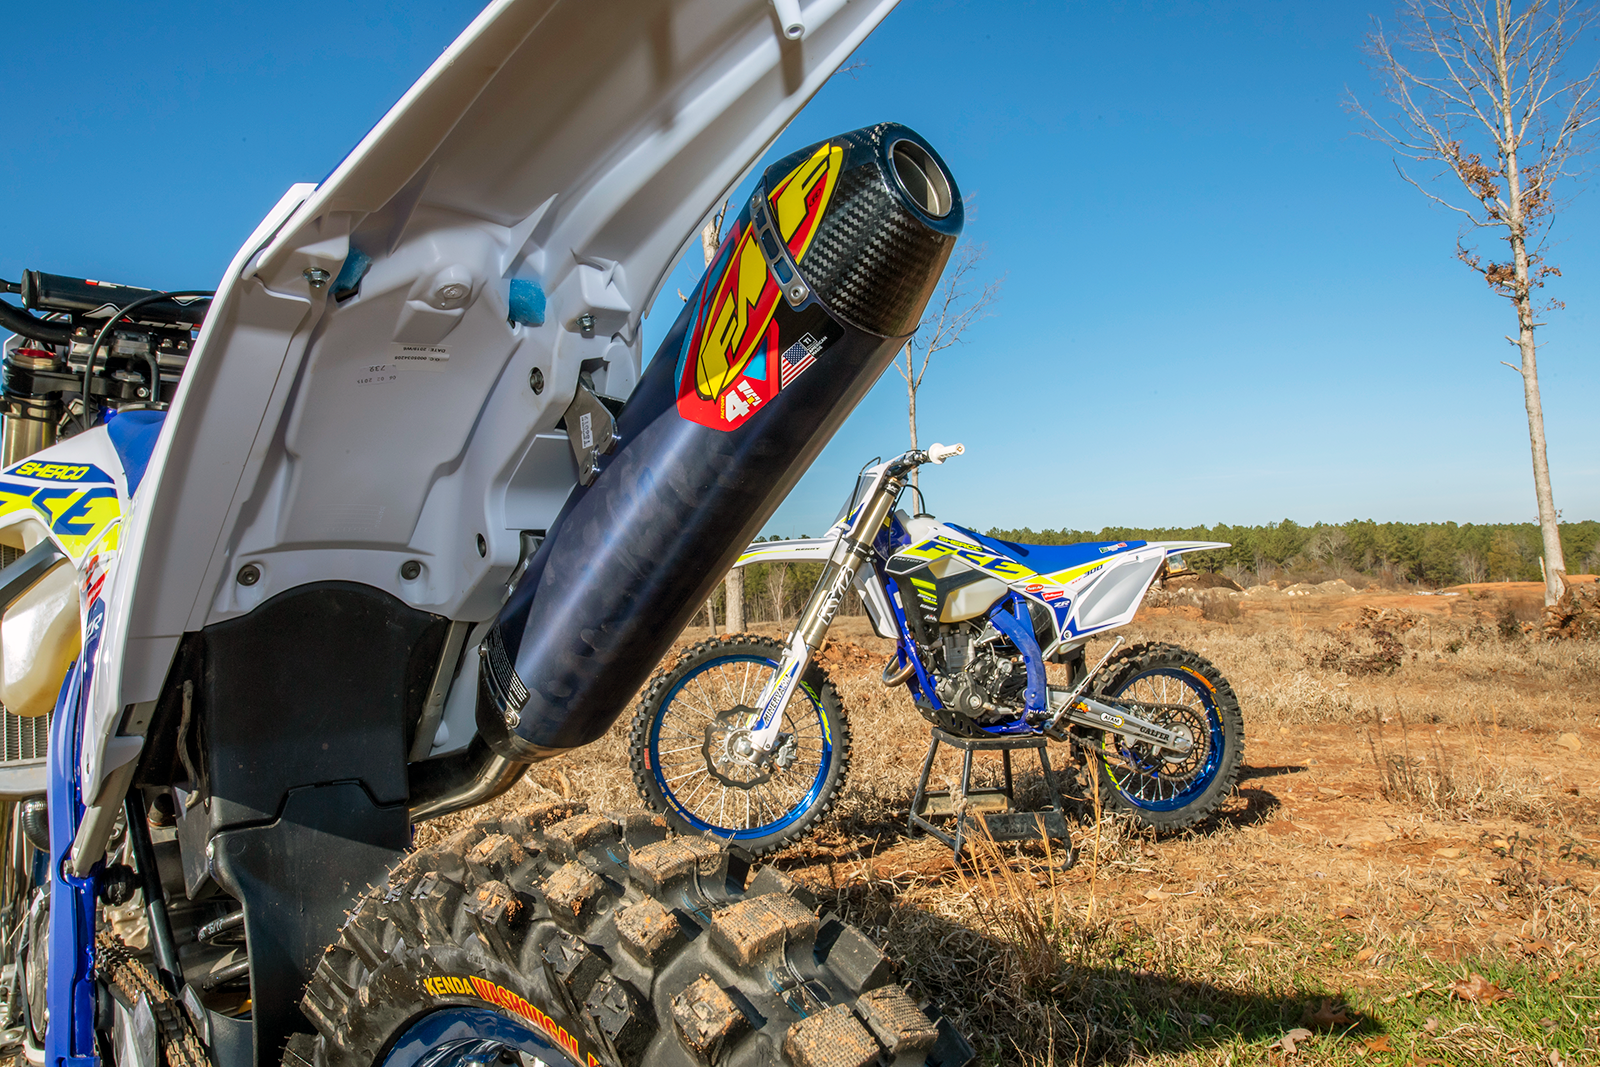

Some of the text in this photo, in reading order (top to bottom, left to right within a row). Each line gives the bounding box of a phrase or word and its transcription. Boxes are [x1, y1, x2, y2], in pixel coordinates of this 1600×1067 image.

[700, 141, 831, 404] FMF
[15, 461, 90, 481] SHERCO
[938, 535, 983, 552] SHERCO
[914, 540, 1020, 575] FSE
[1083, 564, 1104, 578] 300
[763, 686, 786, 727] MINERVA
[1139, 726, 1170, 742] GALFER
[423, 975, 586, 1067] KENDA WASHOUGAL
